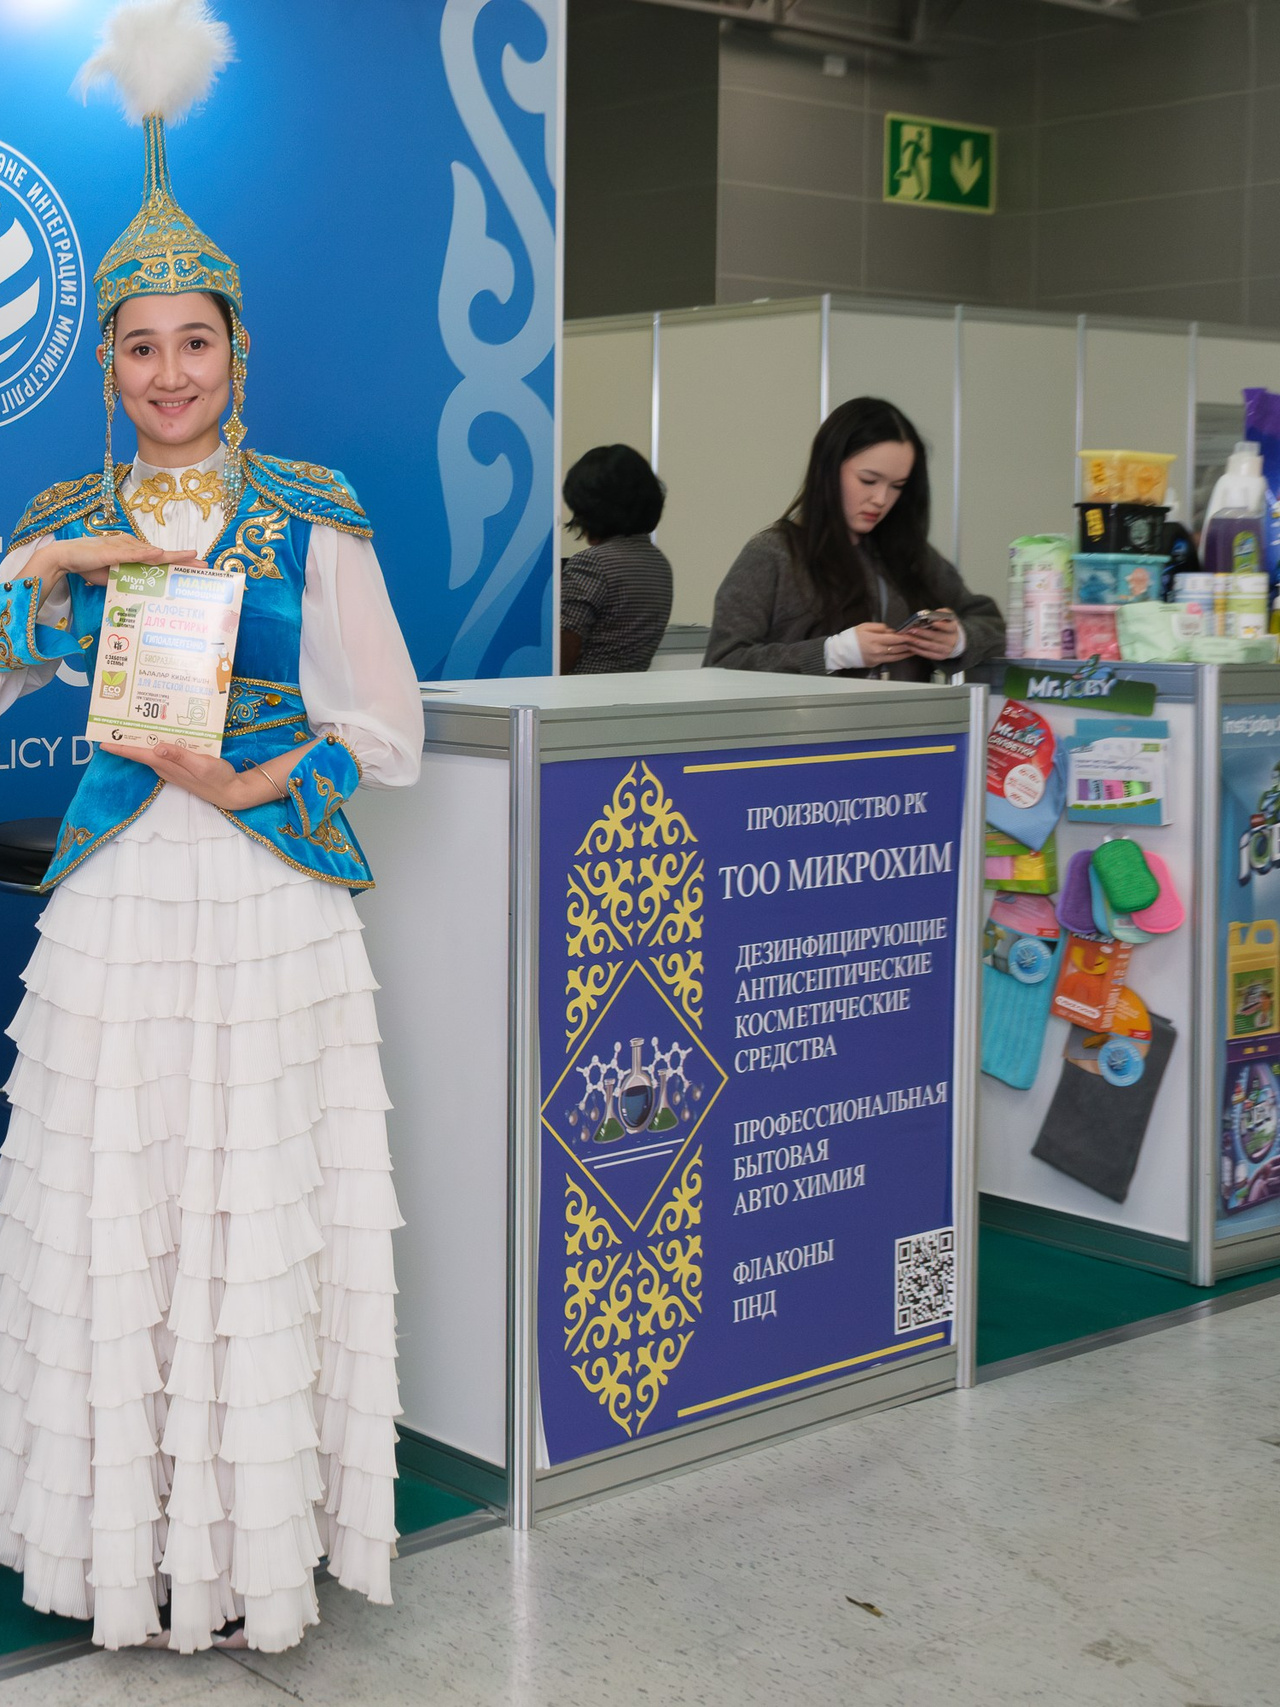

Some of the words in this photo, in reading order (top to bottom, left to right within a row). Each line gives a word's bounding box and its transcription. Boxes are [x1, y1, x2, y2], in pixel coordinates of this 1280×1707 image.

[26, 181, 77, 307] ИНТЕГРАЦИЯ
[121, 574, 145, 587] Altyn
[129, 583, 144, 592] ara
[174, 567, 190, 575] MADE
[144, 616, 166, 628] ДЛЯ
[170, 619, 208, 633] СТИРКИ
[147, 603, 205, 619] САЛФЕТКИ
[103, 685, 121, 694] ECO
[135, 702, 159, 719] +30
[746, 795, 901, 831] ПРОИЗВОДСТВО
[904, 792, 928, 815] РК
[718, 861, 781, 900] ТОО
[787, 841, 953, 892] МИКРОХИМ
[735, 917, 948, 974] ДЕЗИНФИЦИРУЮЩИЕ
[735, 952, 932, 1003] АНТИСЕПТИЧЕСКИЕ
[734, 988, 911, 1039] КОСМЕТИЧЕСКИЕ
[734, 1034, 837, 1073] СРЕДСТВА
[733, 1081, 948, 1146] ПРОФЕССИОНАЛЬНАЯ
[733, 1138, 829, 1181] БЫТОВАЯ
[733, 1182, 788, 1216] АВТО
[792, 1164, 866, 1202] ХИМИЯ
[733, 1239, 835, 1286] ФЛАКОНЫ
[733, 1290, 777, 1323] ПНД
